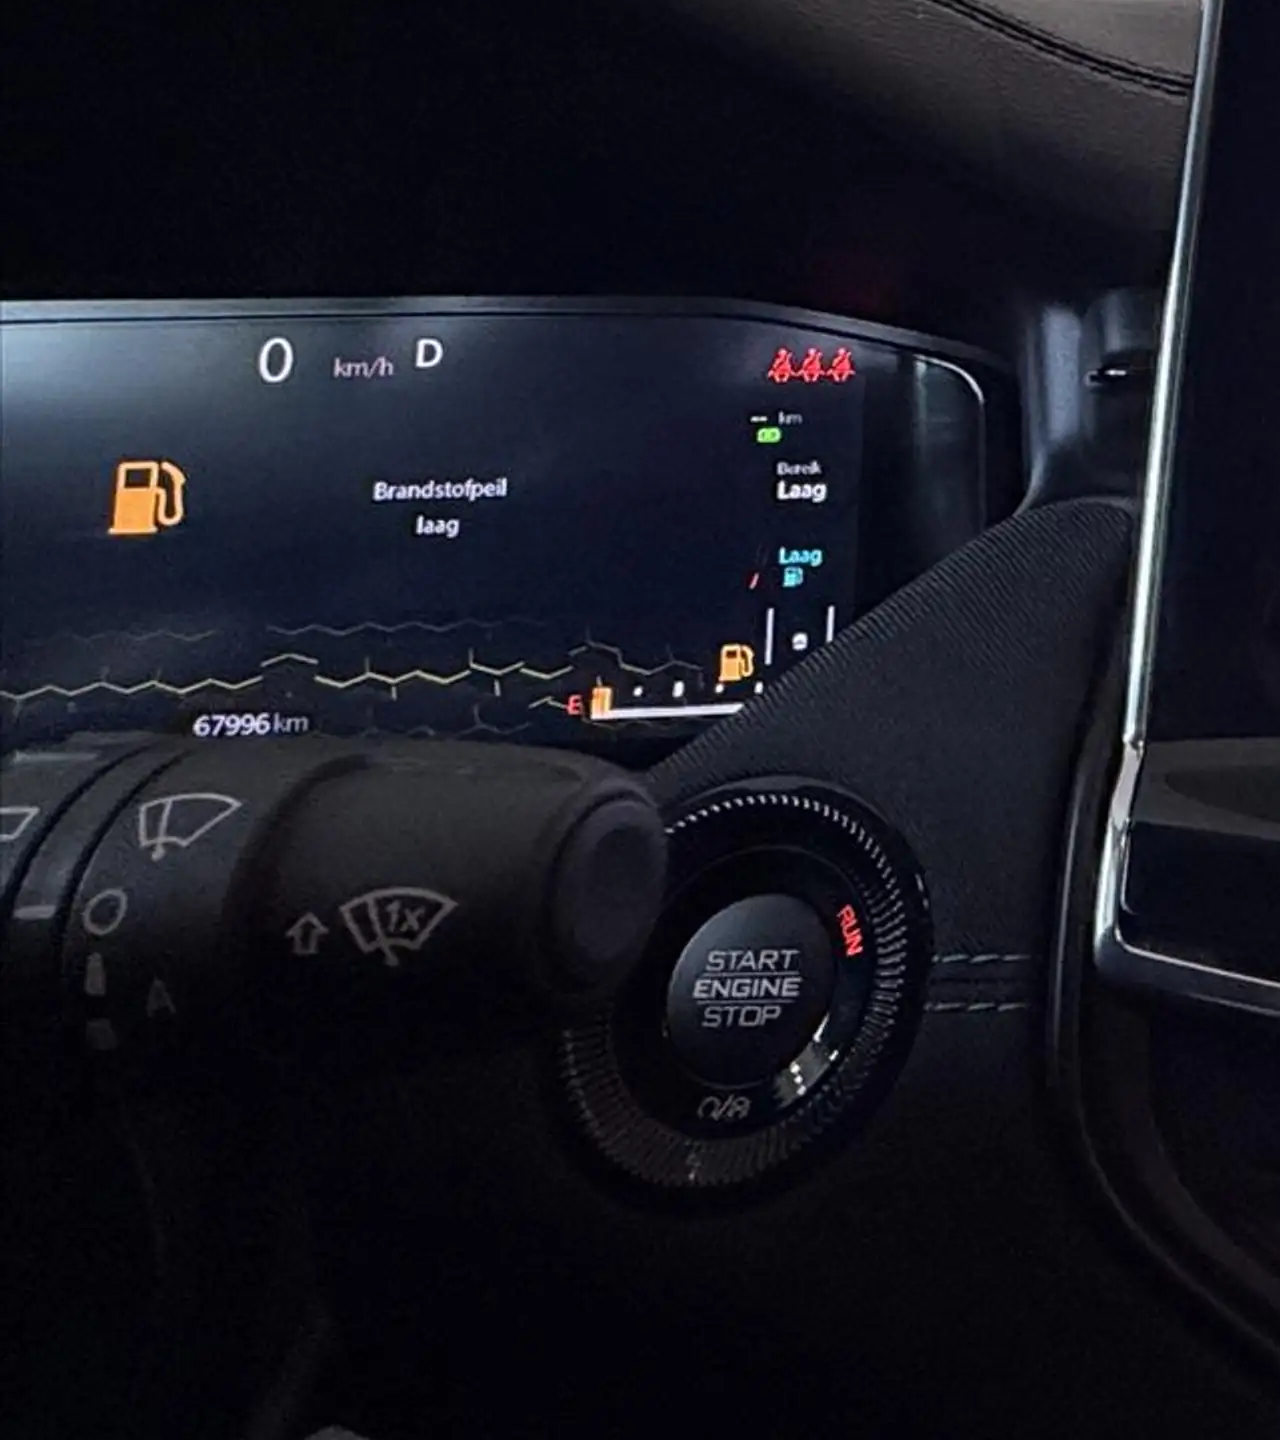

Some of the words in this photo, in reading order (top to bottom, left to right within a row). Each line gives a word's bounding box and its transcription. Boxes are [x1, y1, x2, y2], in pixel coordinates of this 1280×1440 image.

[259, 337, 294, 383] 0
[333, 357, 394, 379] km/h
[415, 337, 443, 368] D
[777, 411, 804, 425] km
[373, 477, 508, 503] Brandstofpeil
[776, 480, 828, 503] Laag
[415, 515, 460, 538] laag
[778, 546, 824, 567] Laag
[567, 694, 583, 715] E
[192, 712, 271, 737] 67996
[272, 714, 310, 733] km
[384, 901, 426, 933] 1x
[836, 903, 864, 957] RUN
[705, 949, 800, 972] START
[692, 976, 801, 999] ENGINE
[701, 1005, 782, 1028] STOP
